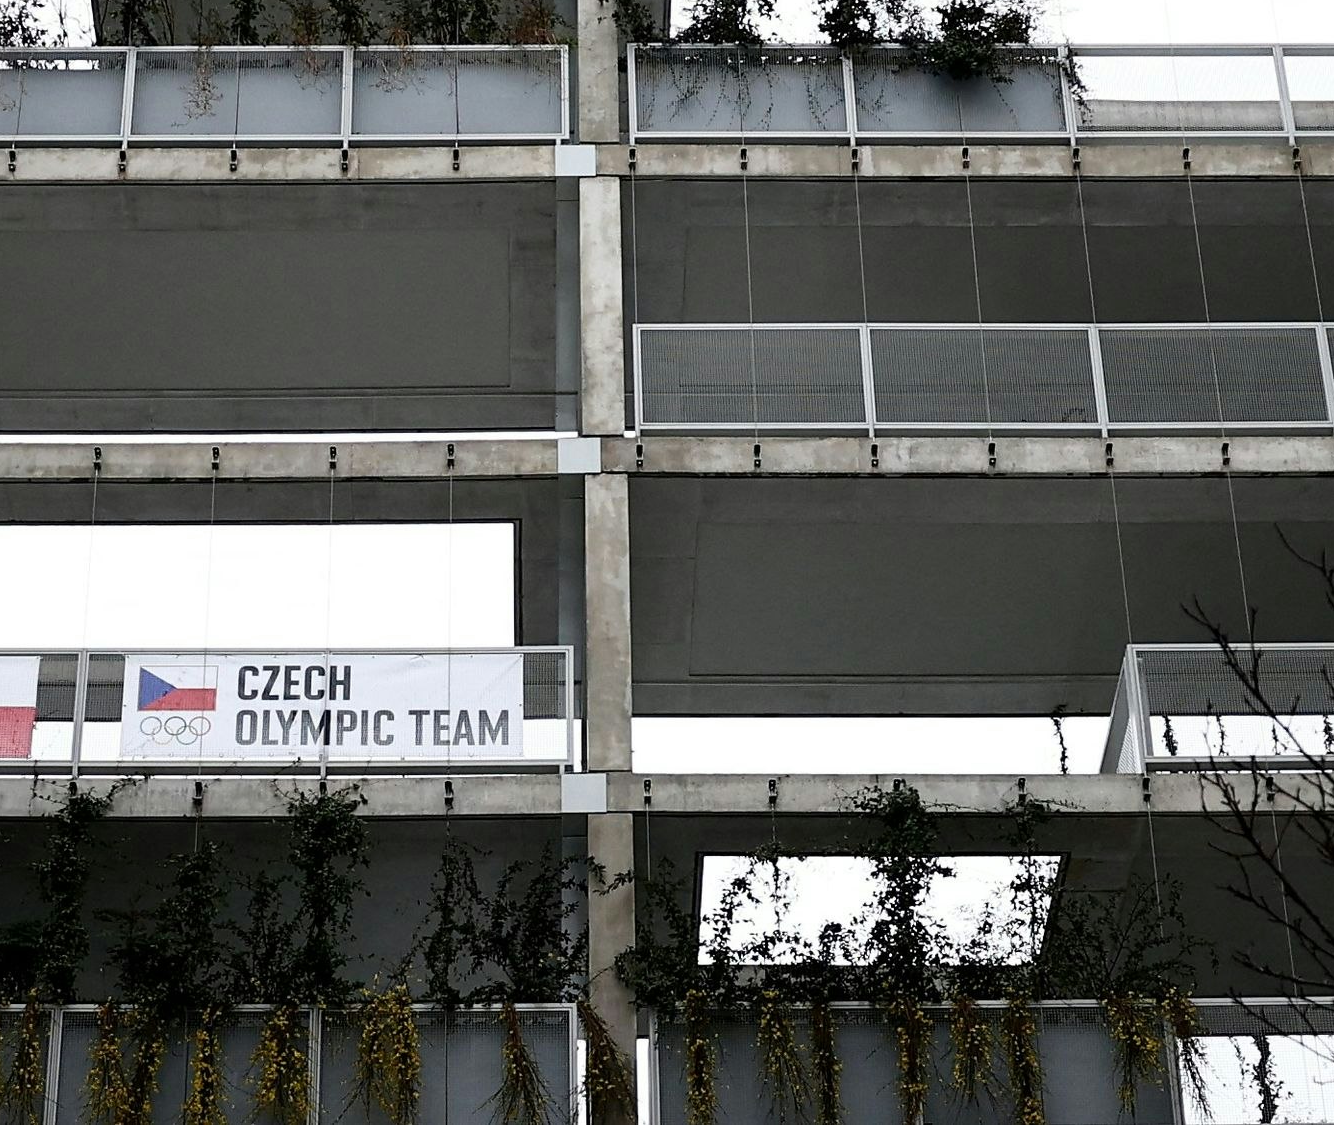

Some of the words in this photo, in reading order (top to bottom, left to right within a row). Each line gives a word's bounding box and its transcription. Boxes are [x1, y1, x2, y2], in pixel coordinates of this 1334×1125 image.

[237, 665, 352, 700] CZECH
[235, 709, 395, 746] OLYMPIC
[408, 709, 510, 746] TEAM
